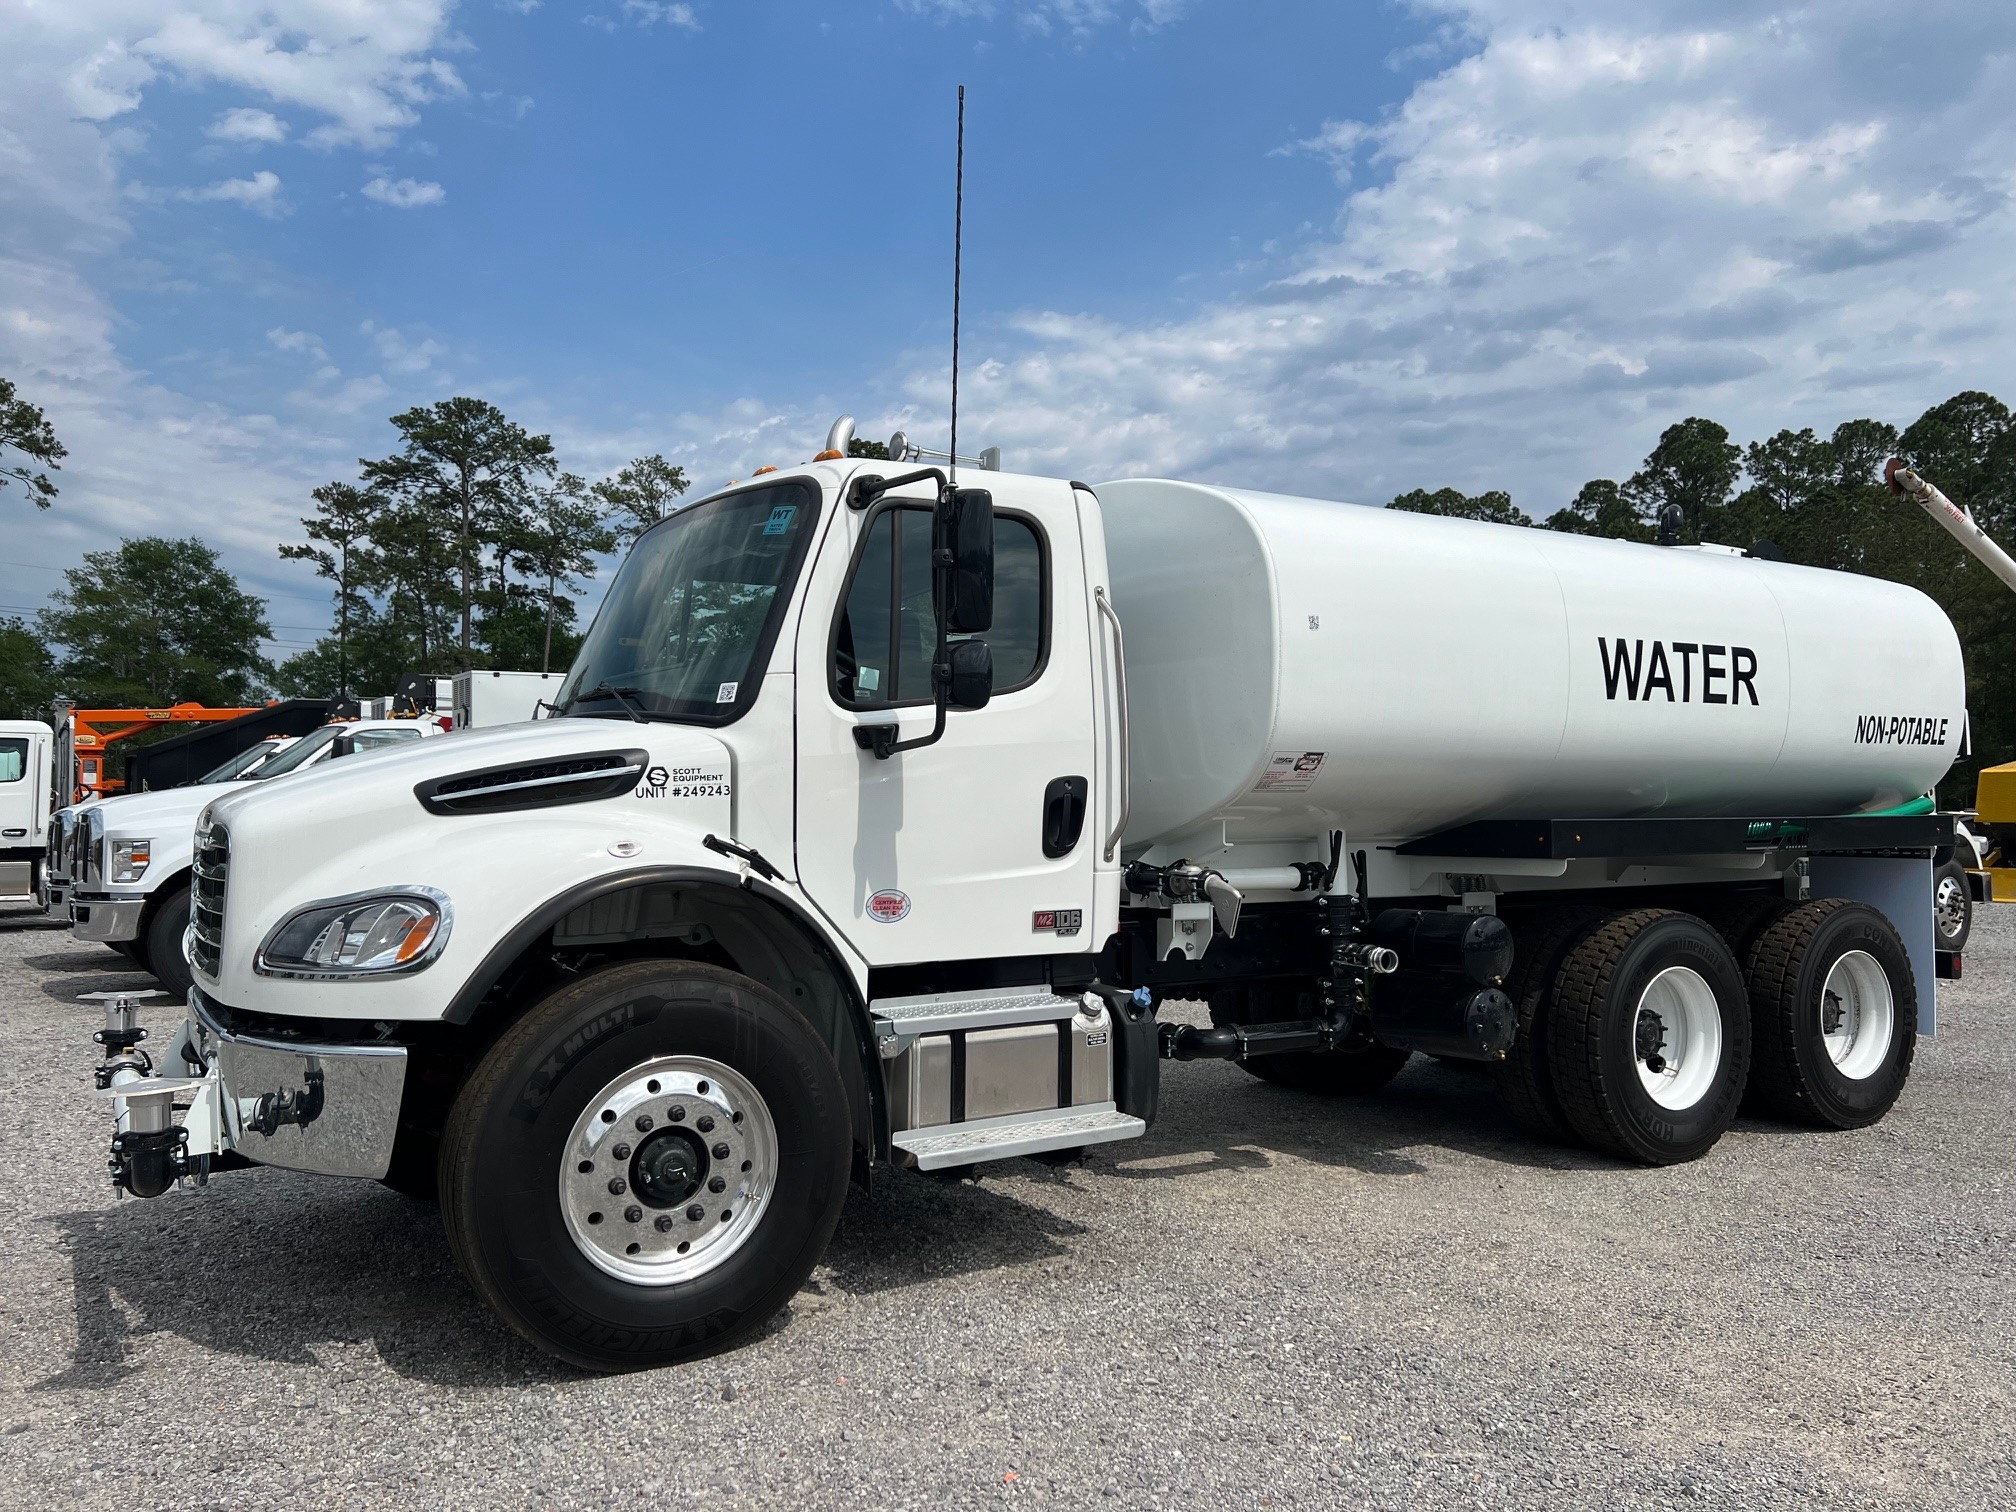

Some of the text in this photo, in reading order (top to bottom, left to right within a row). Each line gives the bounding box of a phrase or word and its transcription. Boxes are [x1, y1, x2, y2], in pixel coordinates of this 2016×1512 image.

[772, 510, 793, 520] WT
[1597, 637, 1760, 706] WATER
[1854, 714, 1948, 746] NON-POTABLE
[672, 774, 724, 782] EQUIPMENT
[635, 785, 731, 798] UNIT #249243
[1037, 910, 1081, 927] M2 106
[1664, 935, 1720, 965] ontinental
[538, 1003, 635, 1080] X MULTI
